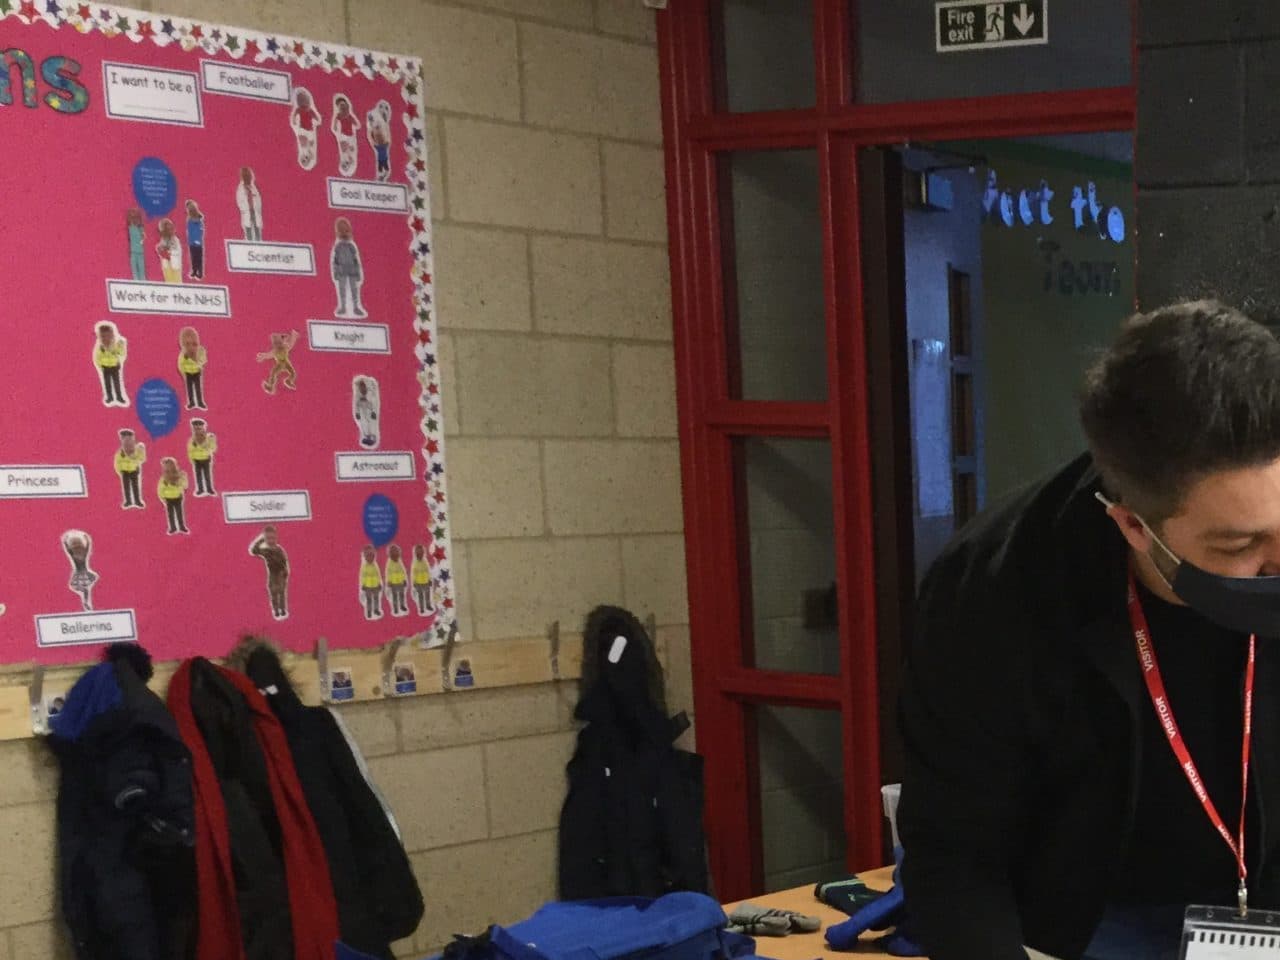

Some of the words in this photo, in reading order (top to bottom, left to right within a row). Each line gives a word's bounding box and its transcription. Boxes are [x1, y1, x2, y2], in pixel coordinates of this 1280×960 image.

[947, 9, 975, 26] Fire
[948, 25, 974, 42] exit
[111, 71, 118, 84] I
[121, 76, 148, 88] want
[153, 79, 166, 90] to
[168, 80, 184, 92] be
[185, 86, 193, 94] a
[219, 71, 275, 90] Footballer
[340, 186, 361, 200] Goal
[247, 251, 295, 264] Scientist
[115, 289, 147, 302] Work
[150, 290, 168, 303] for
[173, 293, 191, 305] the
[194, 294, 223, 306] NHS
[334, 331, 365, 346] Knight
[352, 460, 399, 471] Astronaut
[7, 474, 59, 487] Princess
[249, 501, 286, 512] Soldier
[60, 621, 113, 635] Ballerina
[1134, 629, 1154, 672] VISITOR
[1155, 696, 1177, 739] VISITOR
[1184, 760, 1207, 803] VISITOR
